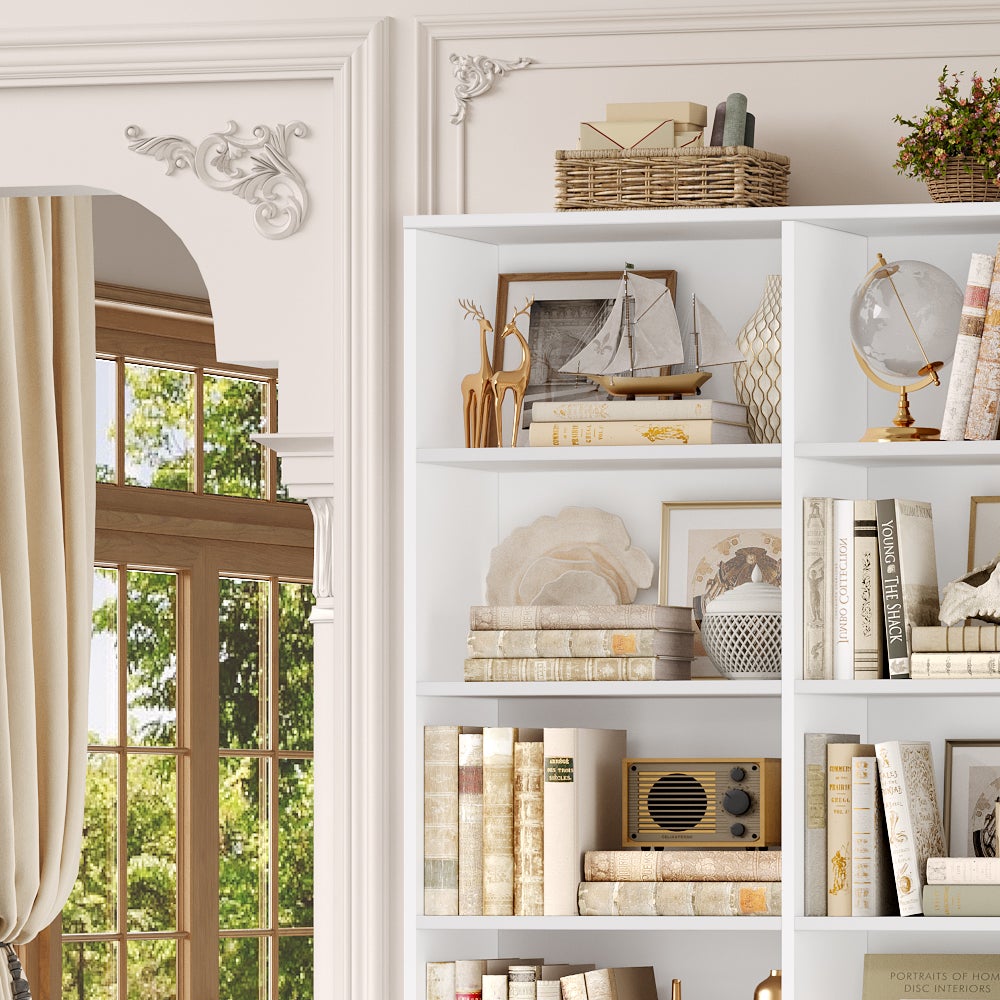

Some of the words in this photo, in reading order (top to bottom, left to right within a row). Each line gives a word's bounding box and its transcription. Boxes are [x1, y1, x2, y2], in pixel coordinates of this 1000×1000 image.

[881, 520, 896, 564] YOUNG
[884, 575, 900, 601] THE
[887, 603, 903, 644] SHACK
[890, 971, 948, 981] PORTRAITS
[952, 971, 968, 981] OF
[904, 984, 930, 993] DISC
[934, 984, 991, 993] INTERIORS
